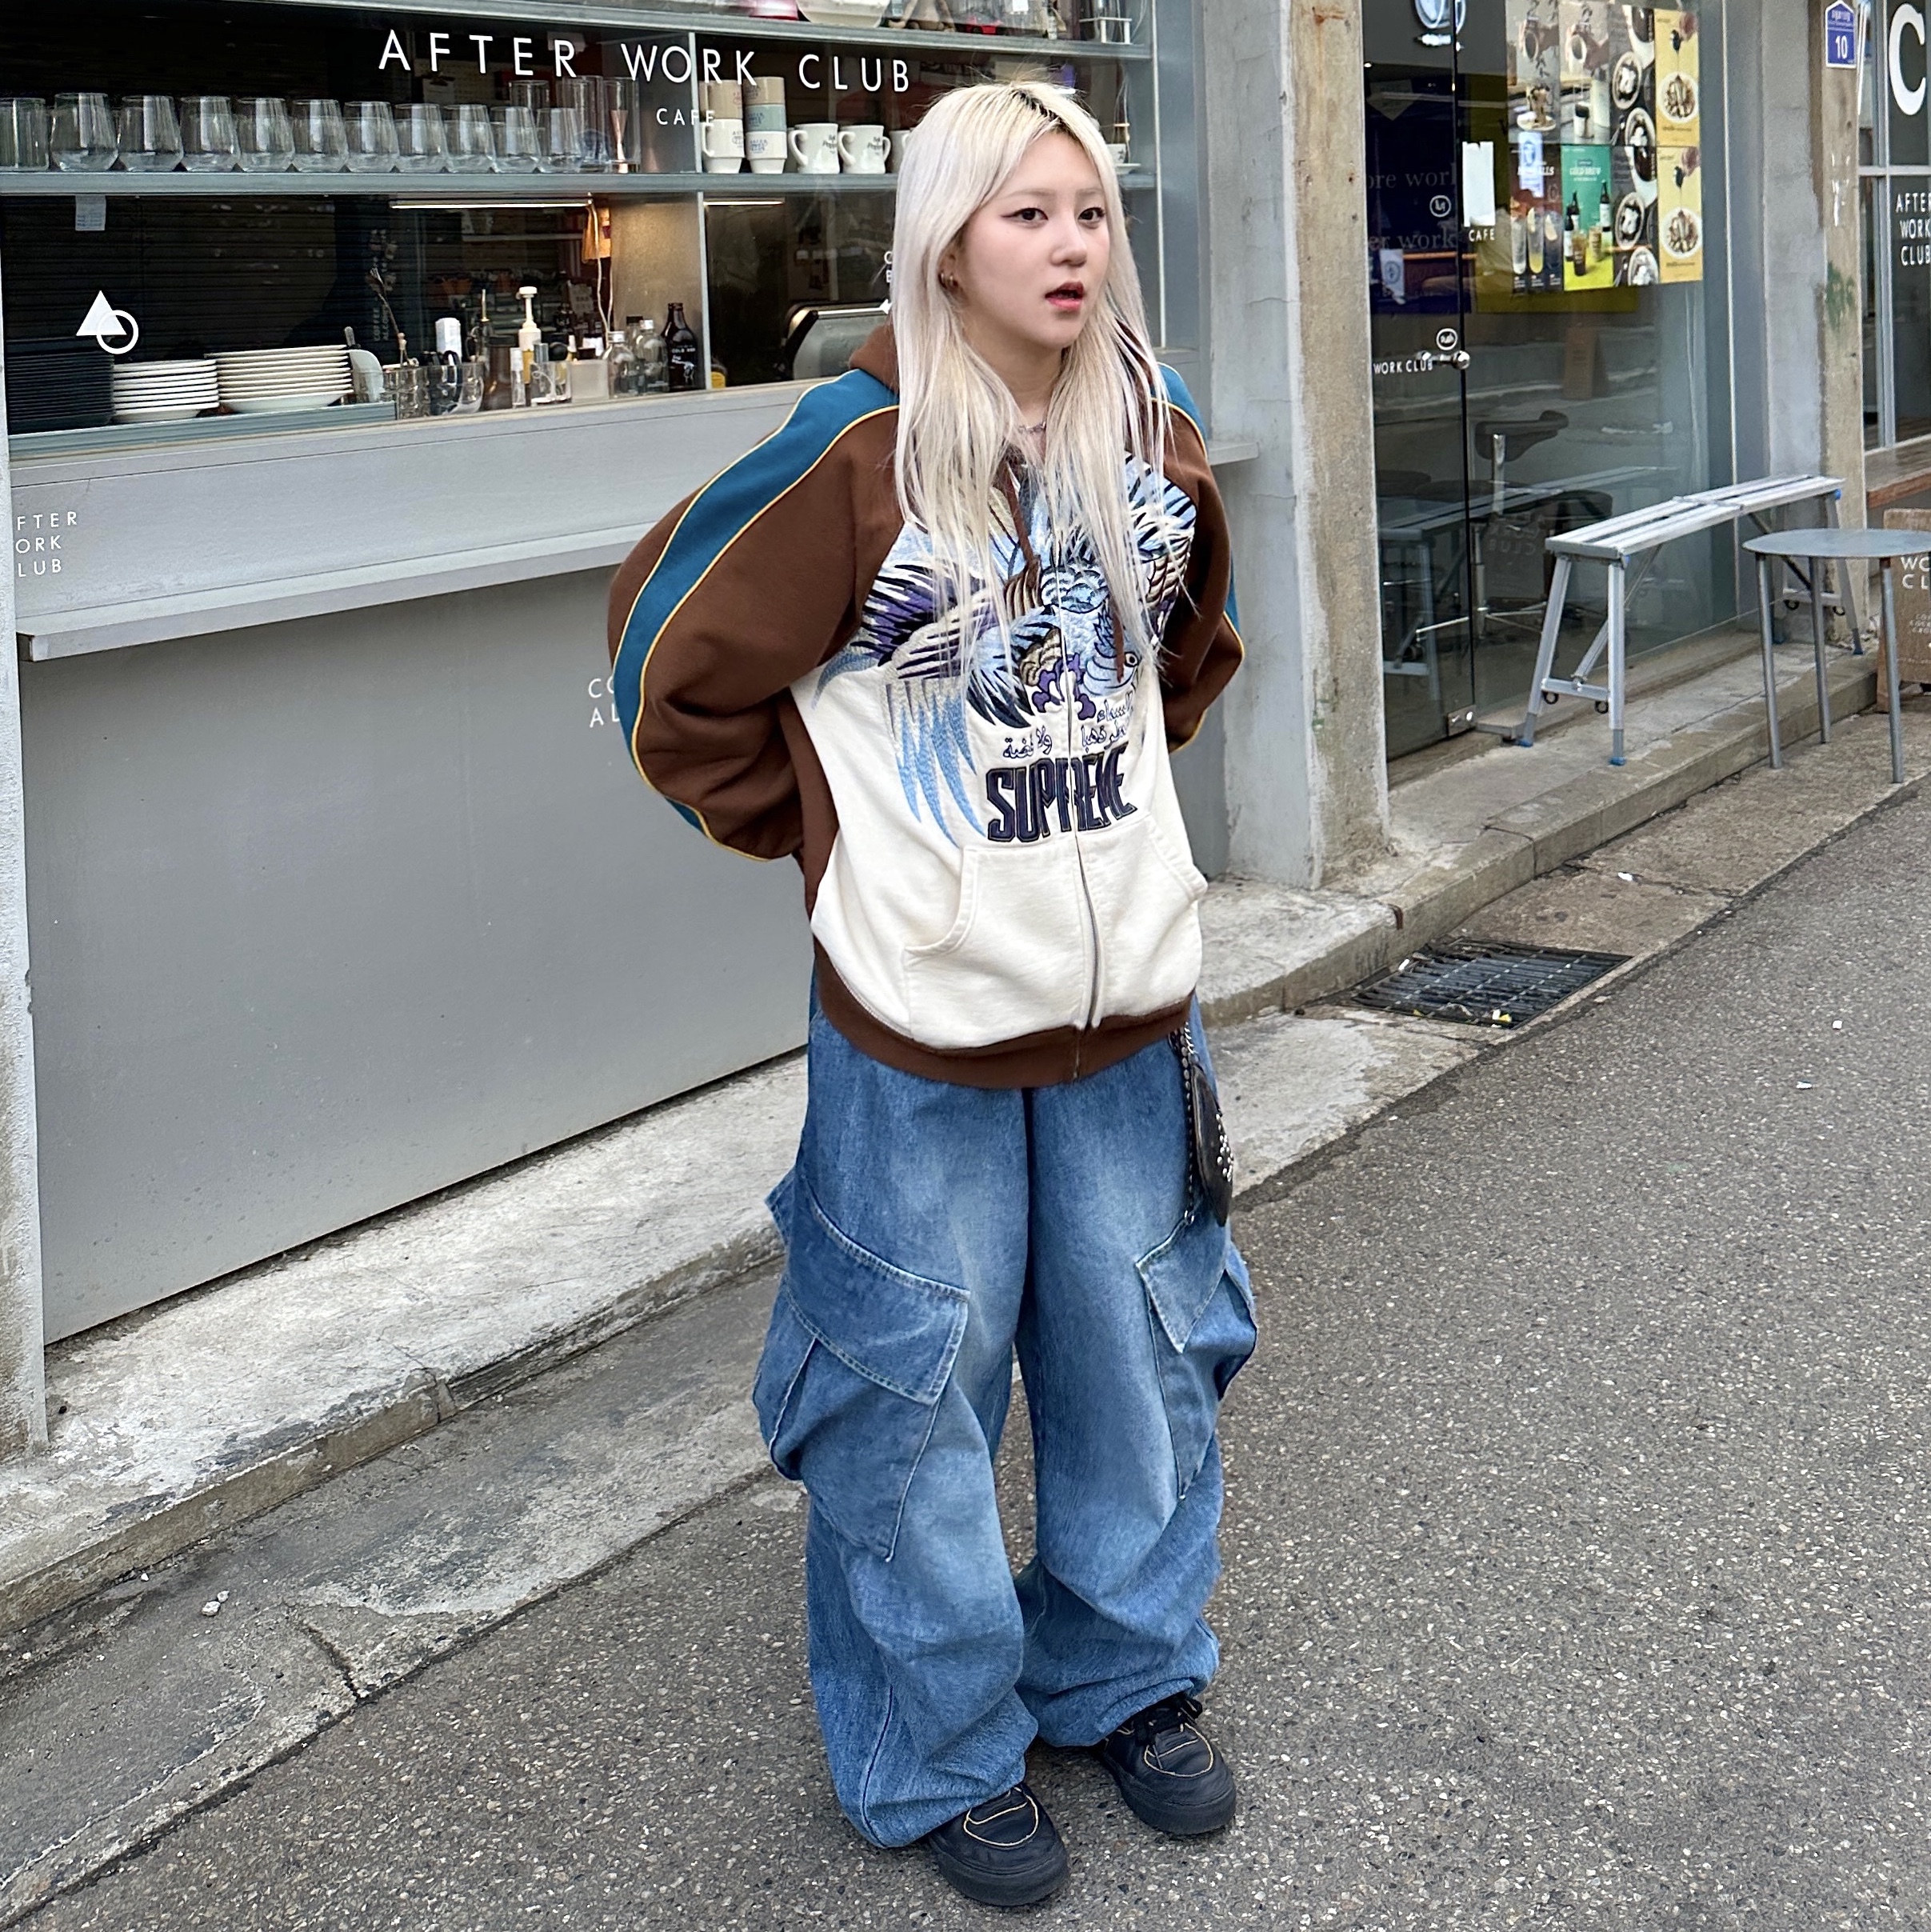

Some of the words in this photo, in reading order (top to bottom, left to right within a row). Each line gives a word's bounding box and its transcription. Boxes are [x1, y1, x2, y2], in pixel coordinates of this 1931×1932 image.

[1835, 35, 1848, 59] 10
[378, 29, 577, 78] AFTER
[621, 43, 757, 86] WORK
[799, 54, 909, 93] CLUB
[656, 107, 715, 127] CAFE
[1469, 229, 1495, 242] CAFE
[1899, 218, 1931, 239] WORK
[1901, 244, 1931, 266] CLUB
[1373, 362, 1403, 374] WORK
[1405, 359, 1433, 373] CLUB
[17, 511, 78, 530] FTER
[15, 534, 62, 554] ORK
[18, 558, 62, 578] LUB
[985, 741, 1138, 843] SUPREME
